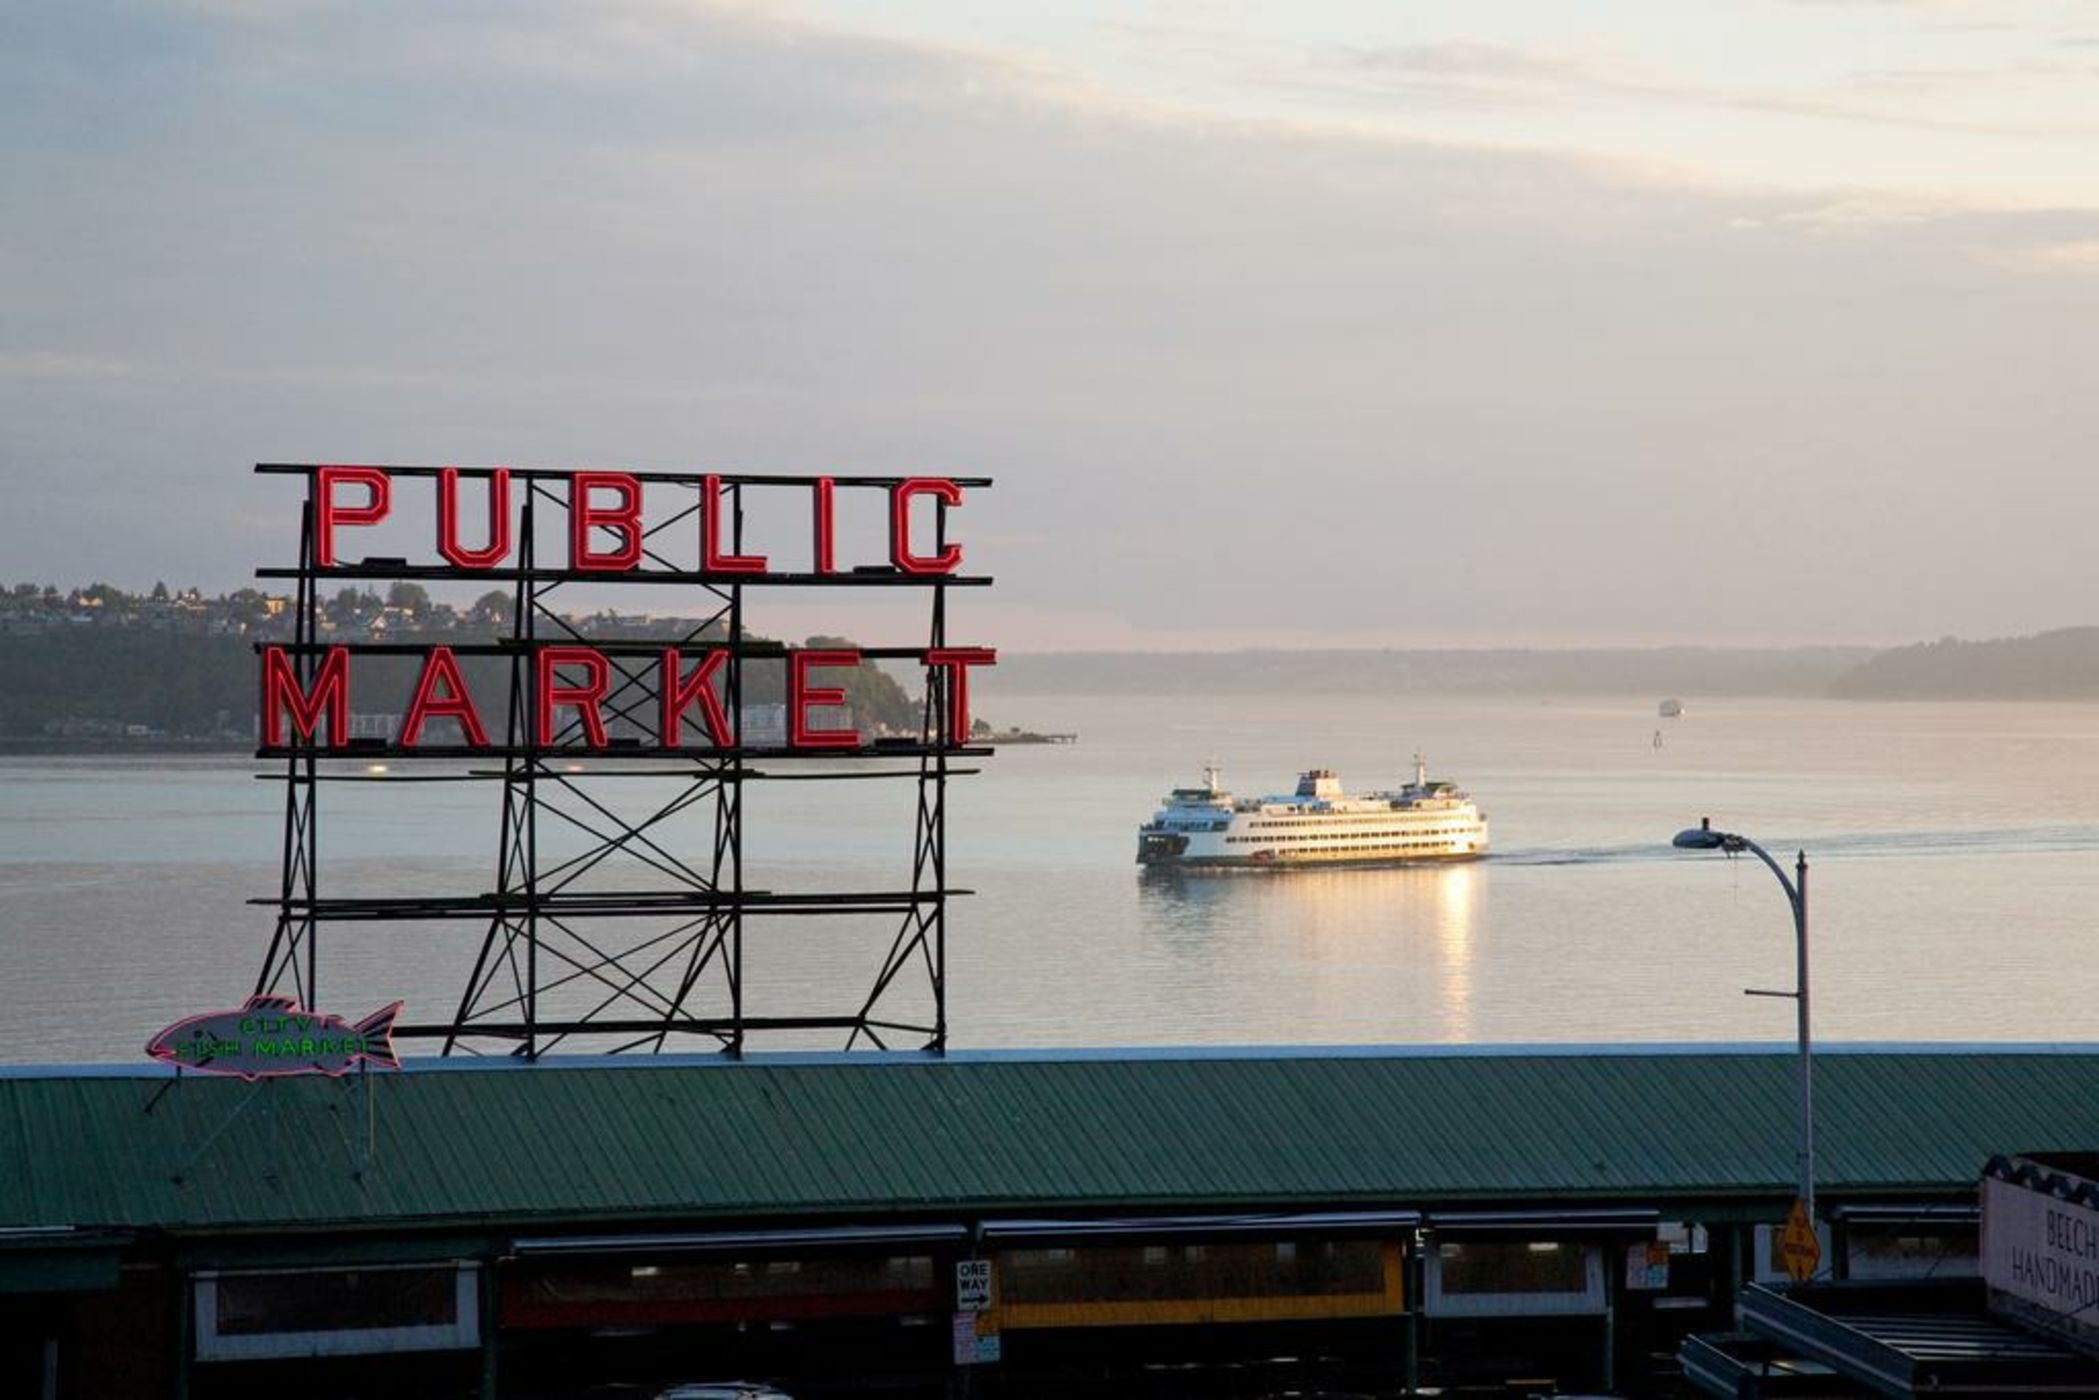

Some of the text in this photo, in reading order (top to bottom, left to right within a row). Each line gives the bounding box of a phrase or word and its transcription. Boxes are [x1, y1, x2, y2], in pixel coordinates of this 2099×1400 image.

[315, 466, 963, 575] PUBLIC
[261, 646, 997, 750] MARKET
[239, 1015, 312, 1033] CITY
[254, 1036, 369, 1057] MARKET
[960, 1262, 989, 1277] ONE
[2012, 1245, 2099, 1310] HANDMAD
[960, 1279, 988, 1291] WAY
